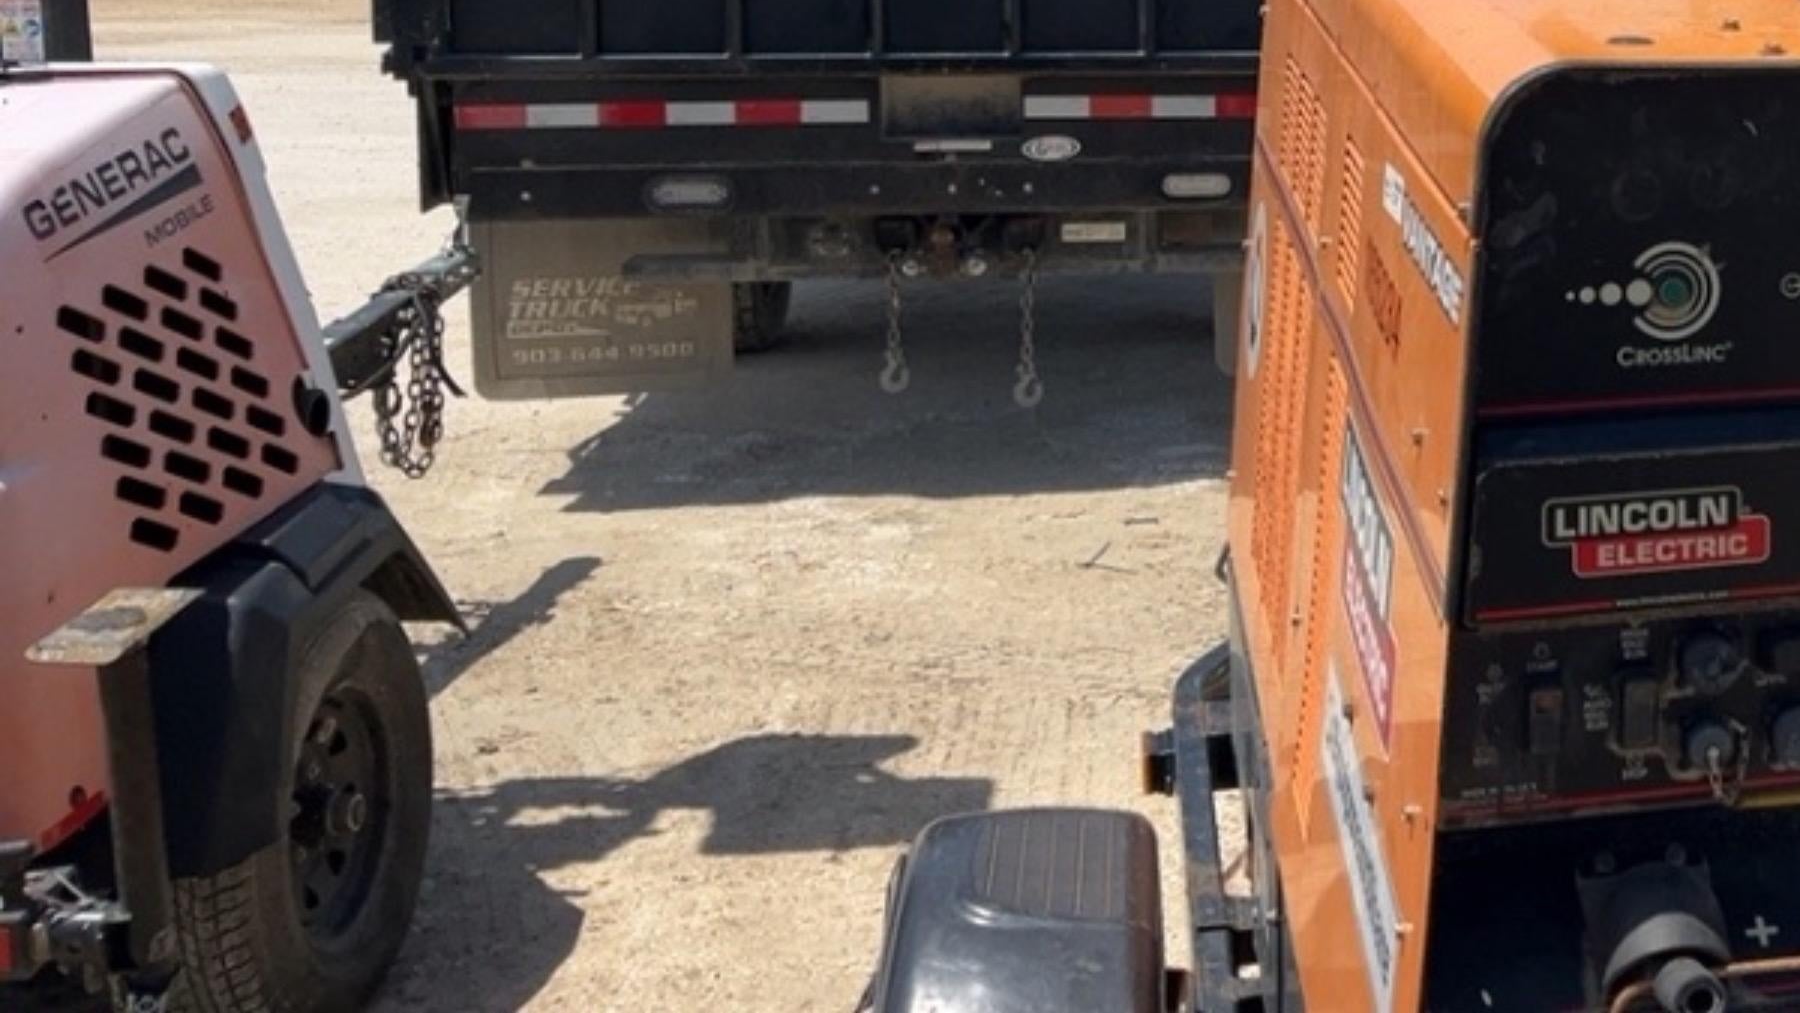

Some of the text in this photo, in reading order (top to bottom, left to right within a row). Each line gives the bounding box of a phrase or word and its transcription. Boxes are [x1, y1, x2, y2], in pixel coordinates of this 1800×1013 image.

[23, 127, 190, 241] GENERAC
[144, 194, 215, 248] MOBILE
[509, 297, 610, 319] TRUCK
[1555, 495, 1729, 538] LINCOLN
[1597, 534, 1748, 568] ELECTRIC
